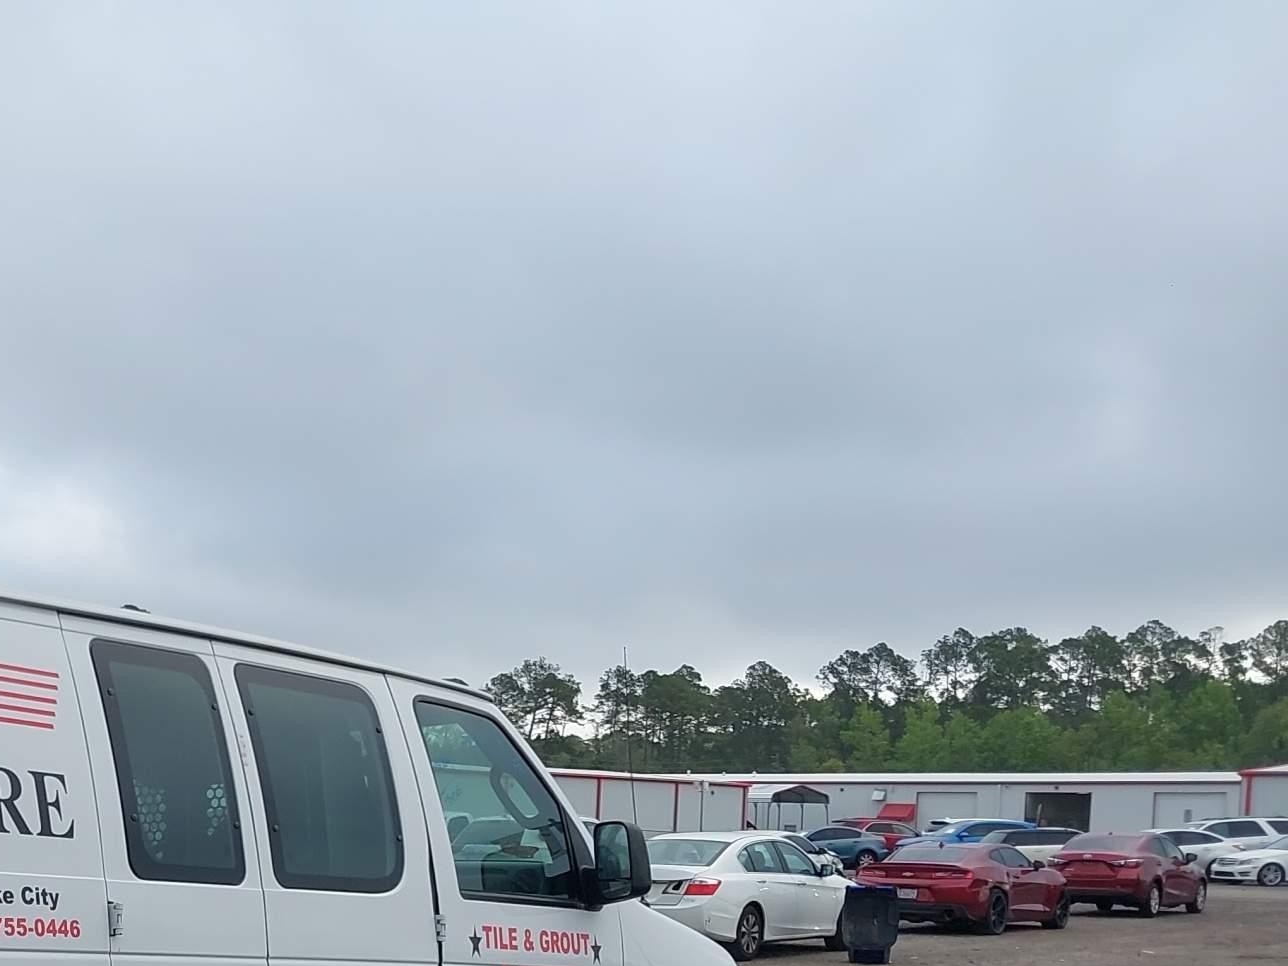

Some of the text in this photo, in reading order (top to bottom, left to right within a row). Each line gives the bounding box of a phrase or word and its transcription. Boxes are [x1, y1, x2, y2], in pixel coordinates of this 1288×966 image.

[20, 886, 60, 911] City
[481, 925, 590, 955] TILE & GROUT
